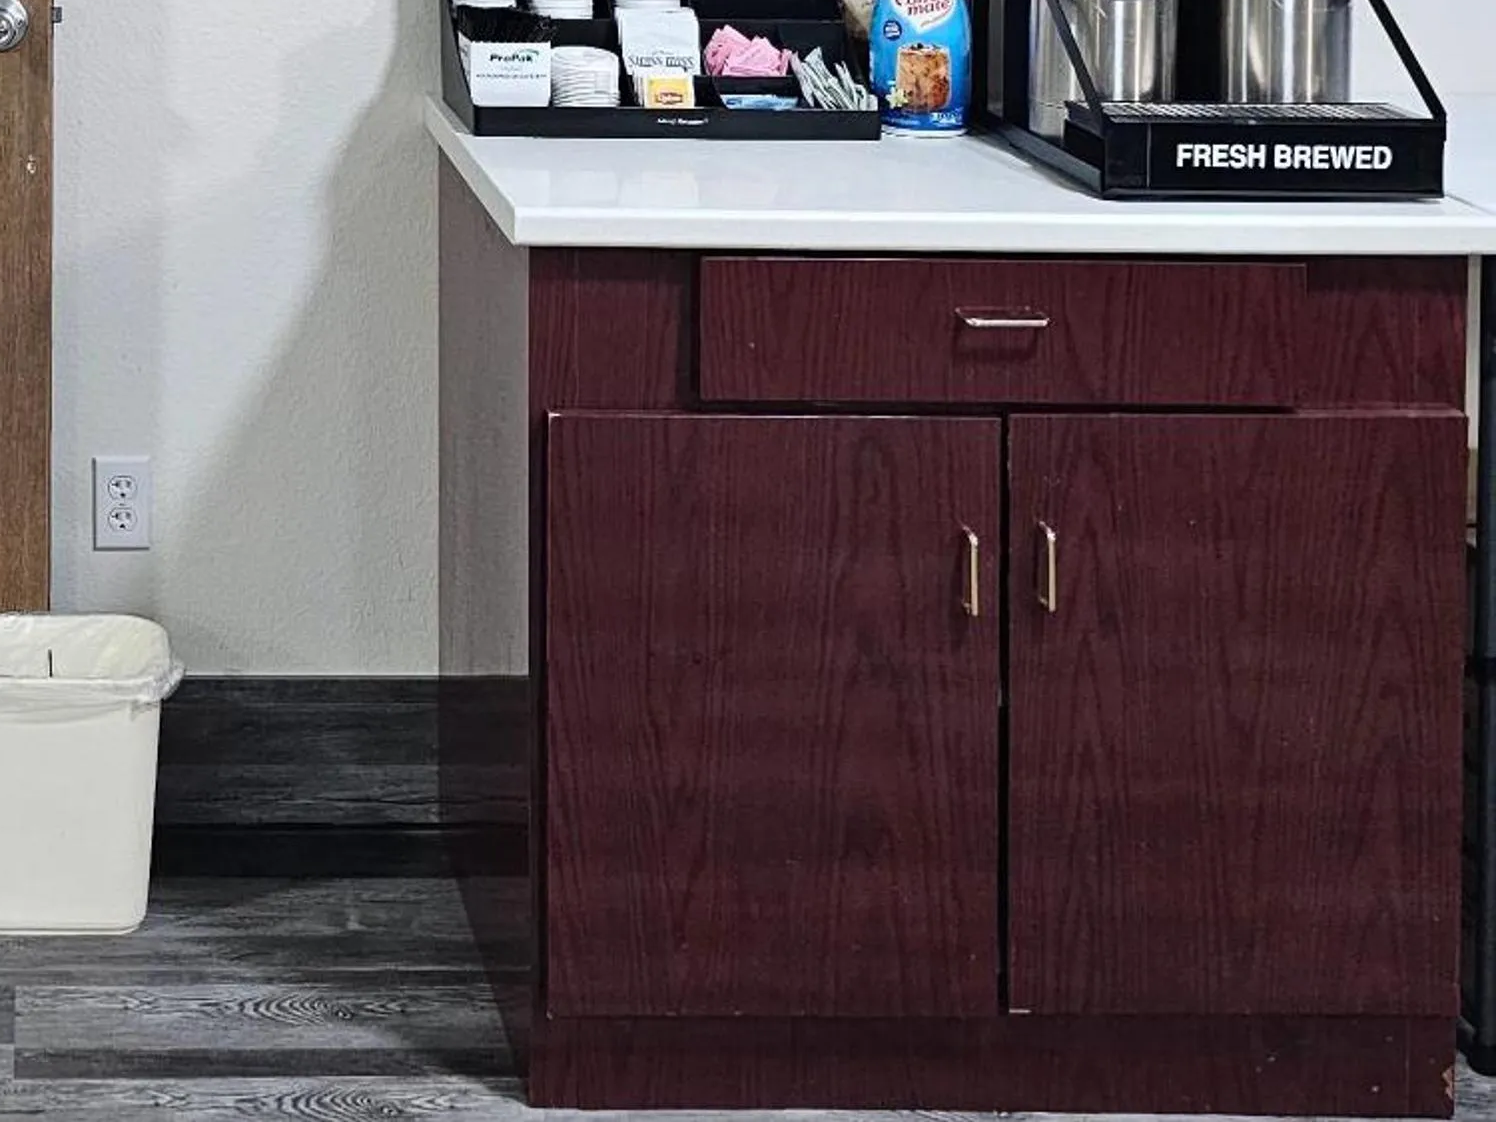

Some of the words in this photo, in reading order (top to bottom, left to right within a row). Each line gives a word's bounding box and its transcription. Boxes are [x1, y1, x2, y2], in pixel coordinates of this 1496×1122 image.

[907, 0, 950, 16] mate
[1176, 144, 1267, 169] FRESH
[1273, 144, 1393, 170] BREWED
